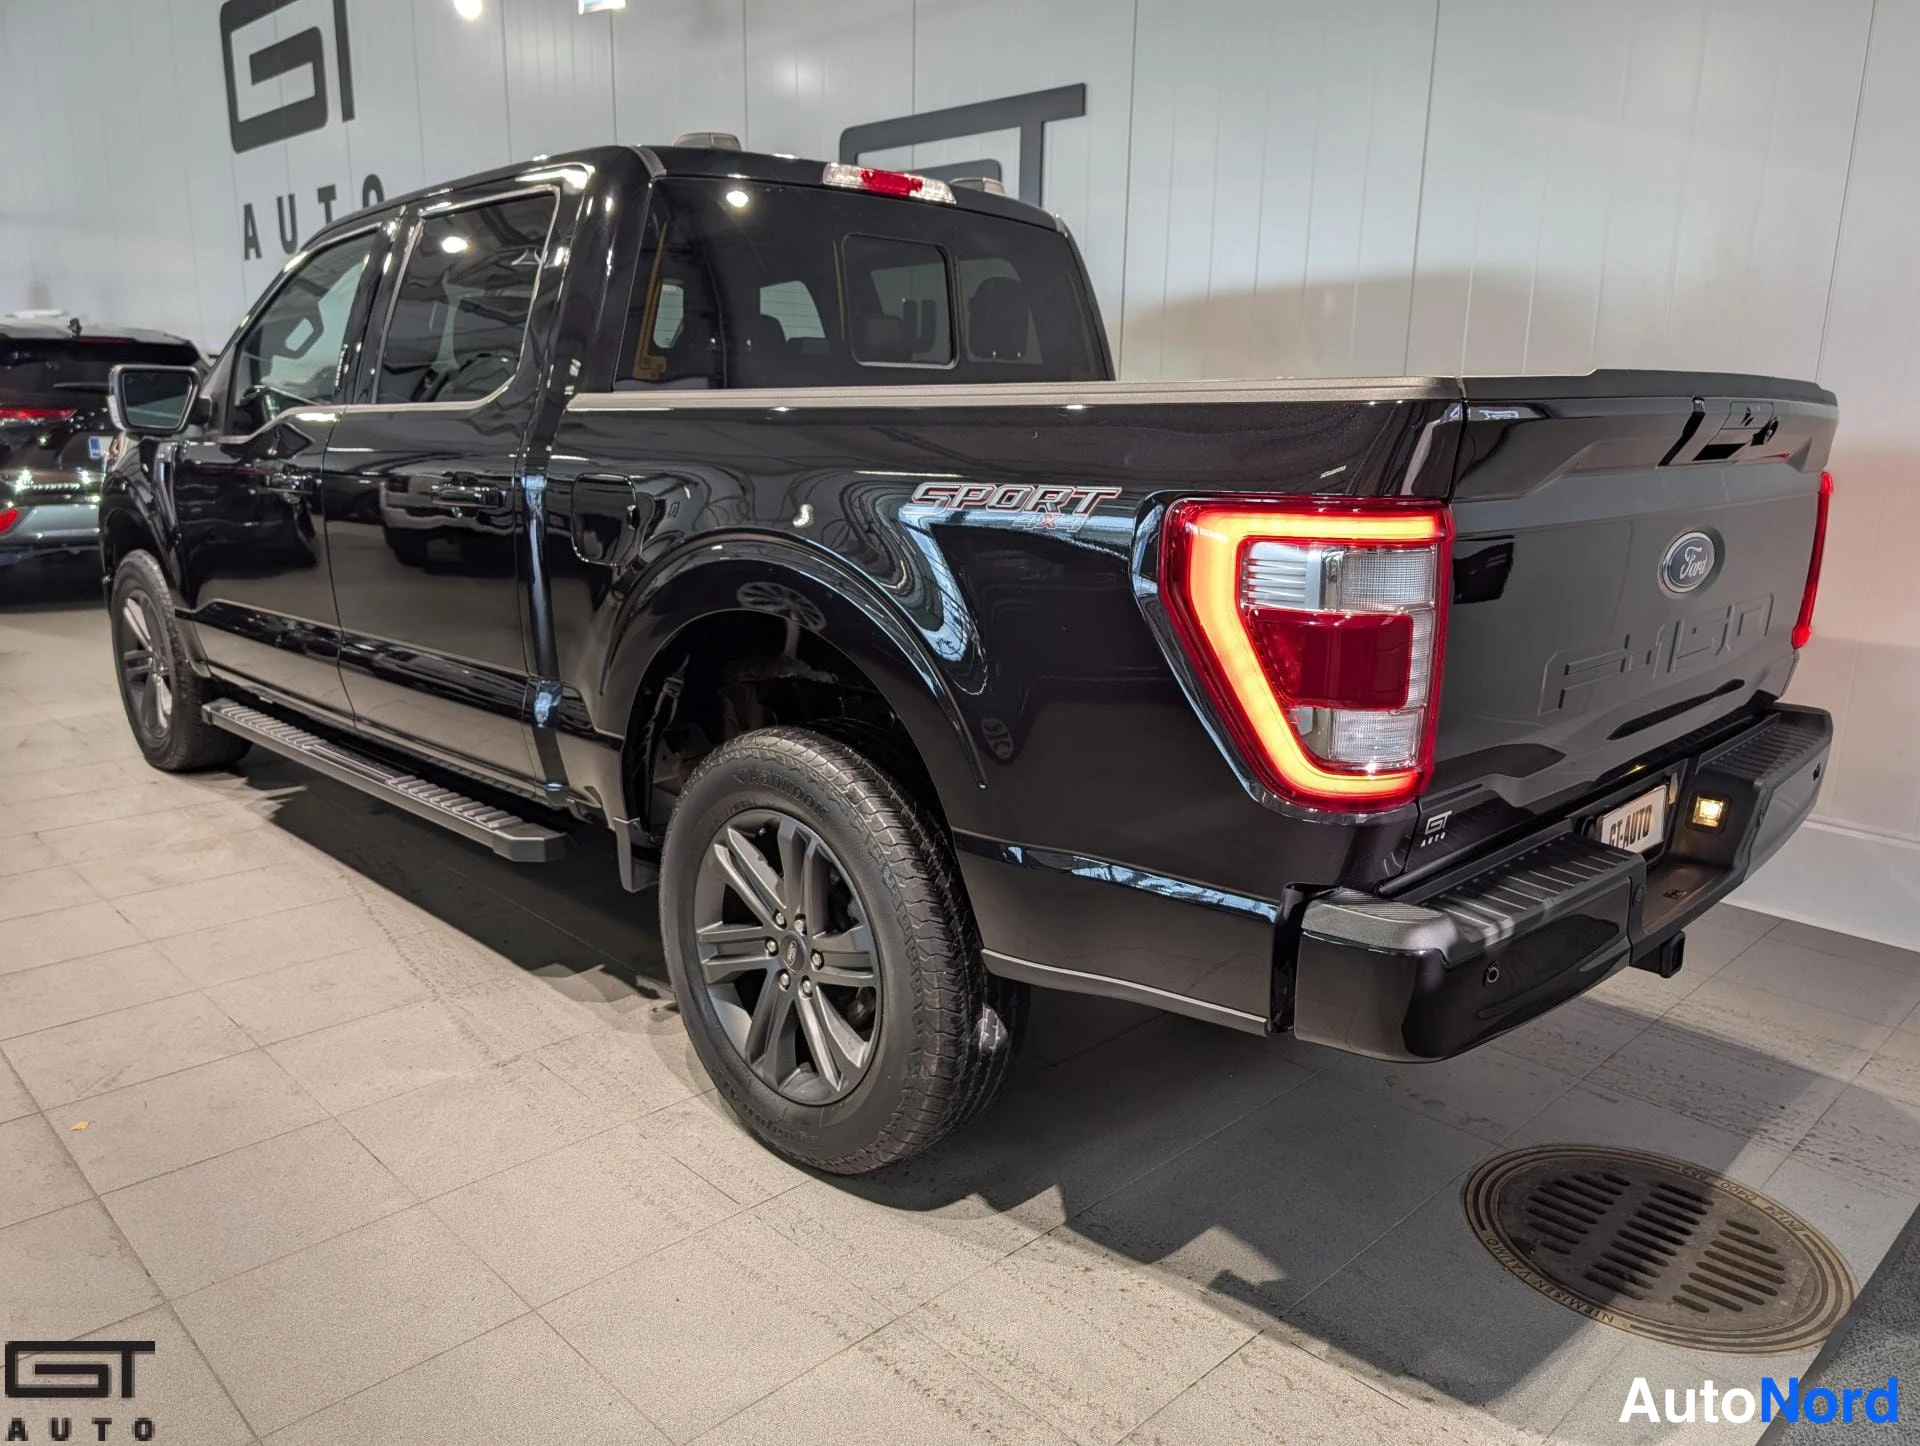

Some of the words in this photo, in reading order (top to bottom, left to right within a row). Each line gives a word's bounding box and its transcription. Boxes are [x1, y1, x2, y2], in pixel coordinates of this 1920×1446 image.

[911, 482, 1122, 516] SPORT
[1679, 546, 1709, 580] Ford
[1537, 592, 1775, 717] F-150
[1420, 831, 1446, 848] AUTO
[1424, 810, 1453, 836] GT
[1608, 804, 1653, 850] GT-AUTO
[1719, 1181, 1757, 1201] D400
[1533, 1280, 1615, 1324] NIEMISEN
